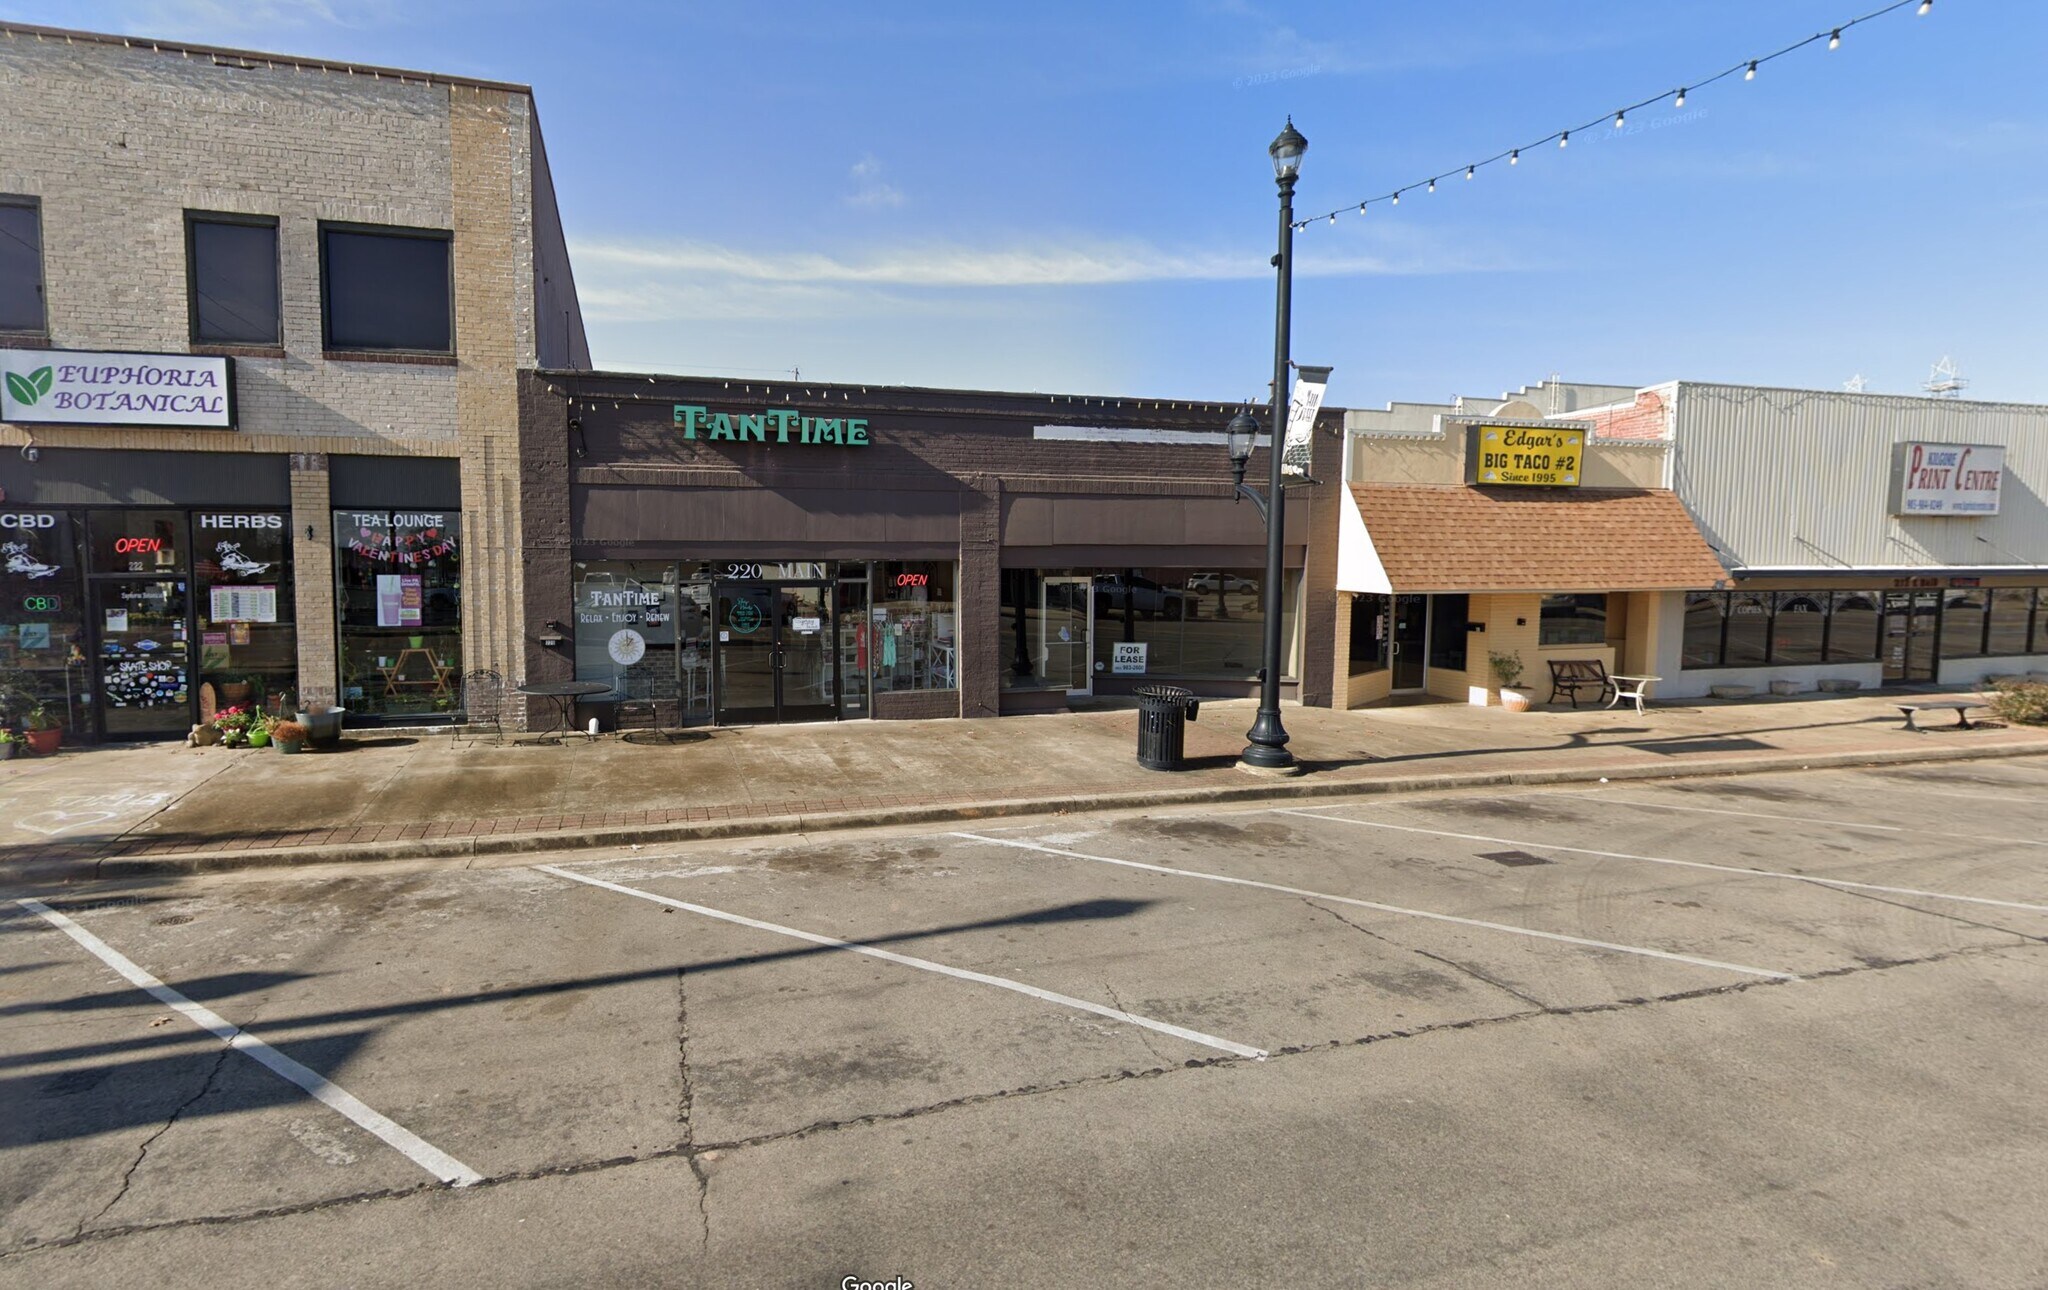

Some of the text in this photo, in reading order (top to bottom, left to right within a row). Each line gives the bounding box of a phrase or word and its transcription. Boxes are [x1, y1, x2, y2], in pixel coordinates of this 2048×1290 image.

[58, 365, 218, 387] EUPHORIA
[54, 391, 223, 413] BOTANICAL
[1503, 429, 1563, 450] Edgar's
[1484, 453, 1575, 470] BIG TACO #2
[1907, 445, 2000, 491] PRINT CENTRE
[1501, 471, 1556, 483] Since 1995
[0, 513, 55, 528] CBD
[201, 514, 282, 529] HERBS
[352, 513, 444, 528] TEA LOUNGE
[115, 538, 161, 553] OPEN
[371, 531, 426, 547] HAPPY
[348, 536, 457, 563] VALENTINES DAY
[727, 563, 824, 579] 220 MAIN
[897, 573, 928, 586] OPEN
[24, 597, 58, 610] CBD
[1793, 603, 1808, 614] FAX
[580, 612, 670, 624] RELAX ENJOY RENEW
[1120, 646, 1140, 654] FOR
[120, 660, 172, 671] SKATE SHOP
[1114, 655, 1144, 663] LEASE
